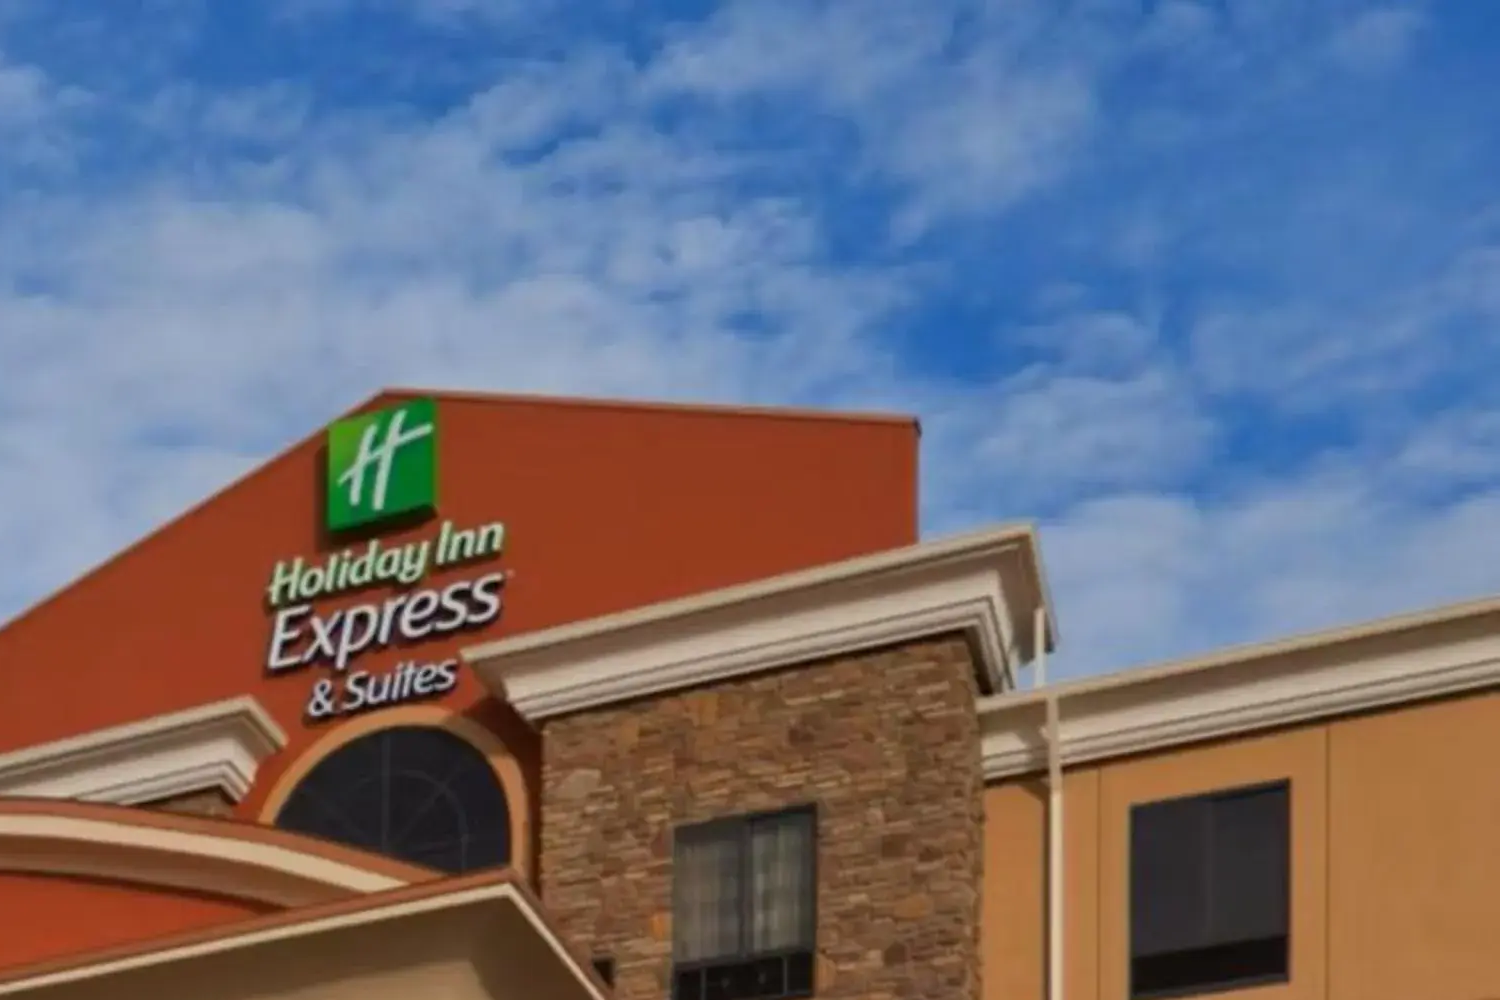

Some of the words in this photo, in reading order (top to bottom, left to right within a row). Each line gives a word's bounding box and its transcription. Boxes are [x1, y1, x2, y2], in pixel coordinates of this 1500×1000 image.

[338, 409, 433, 510] H
[267, 540, 430, 605] Holiday
[436, 520, 504, 565] Inn
[268, 572, 504, 670] Express
[308, 679, 336, 717] &
[343, 659, 458, 711] Suites
